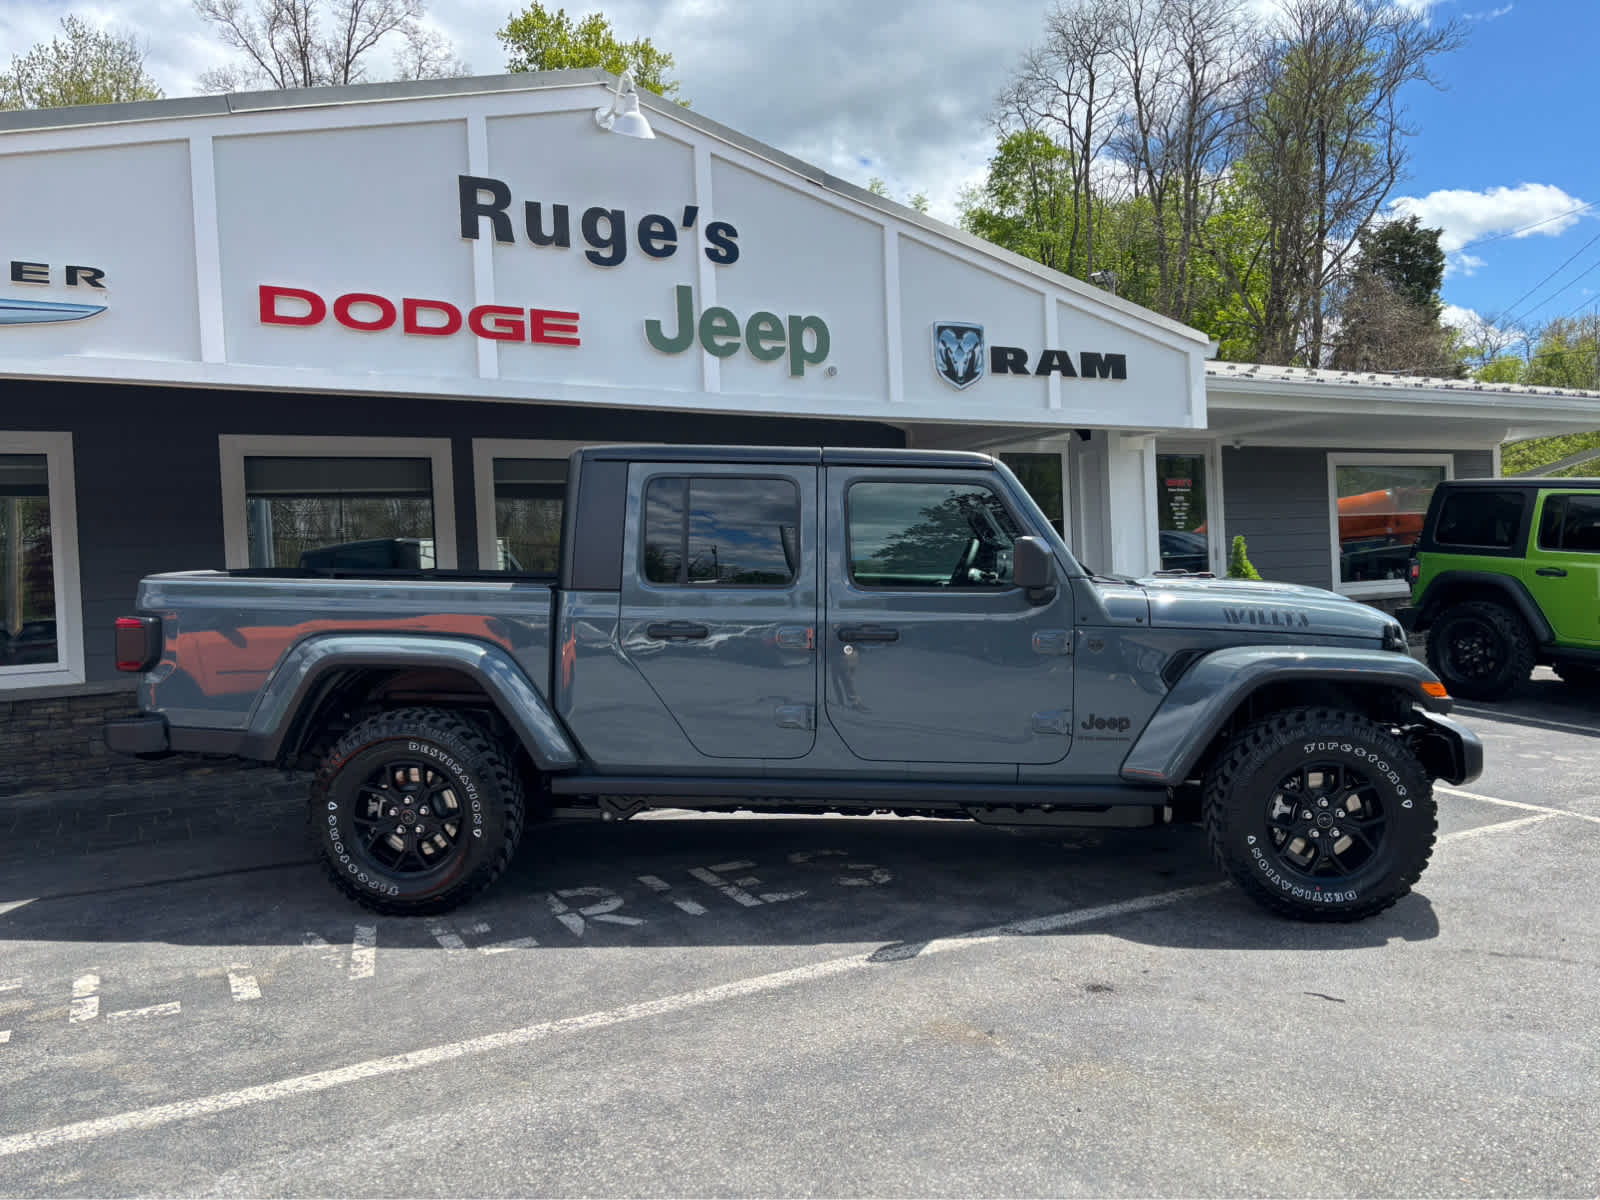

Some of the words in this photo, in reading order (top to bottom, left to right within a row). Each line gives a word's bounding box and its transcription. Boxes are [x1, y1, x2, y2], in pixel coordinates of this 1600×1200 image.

[458, 174, 739, 268] Ruge's
[258, 284, 581, 346] DODGE
[644, 285, 831, 377] Jeep
[990, 346, 1127, 380] RAM
[1080, 713, 1131, 732] Jeep
[408, 741, 482, 825] DESTINATION
[1251, 847, 1358, 902] DESTINATION
